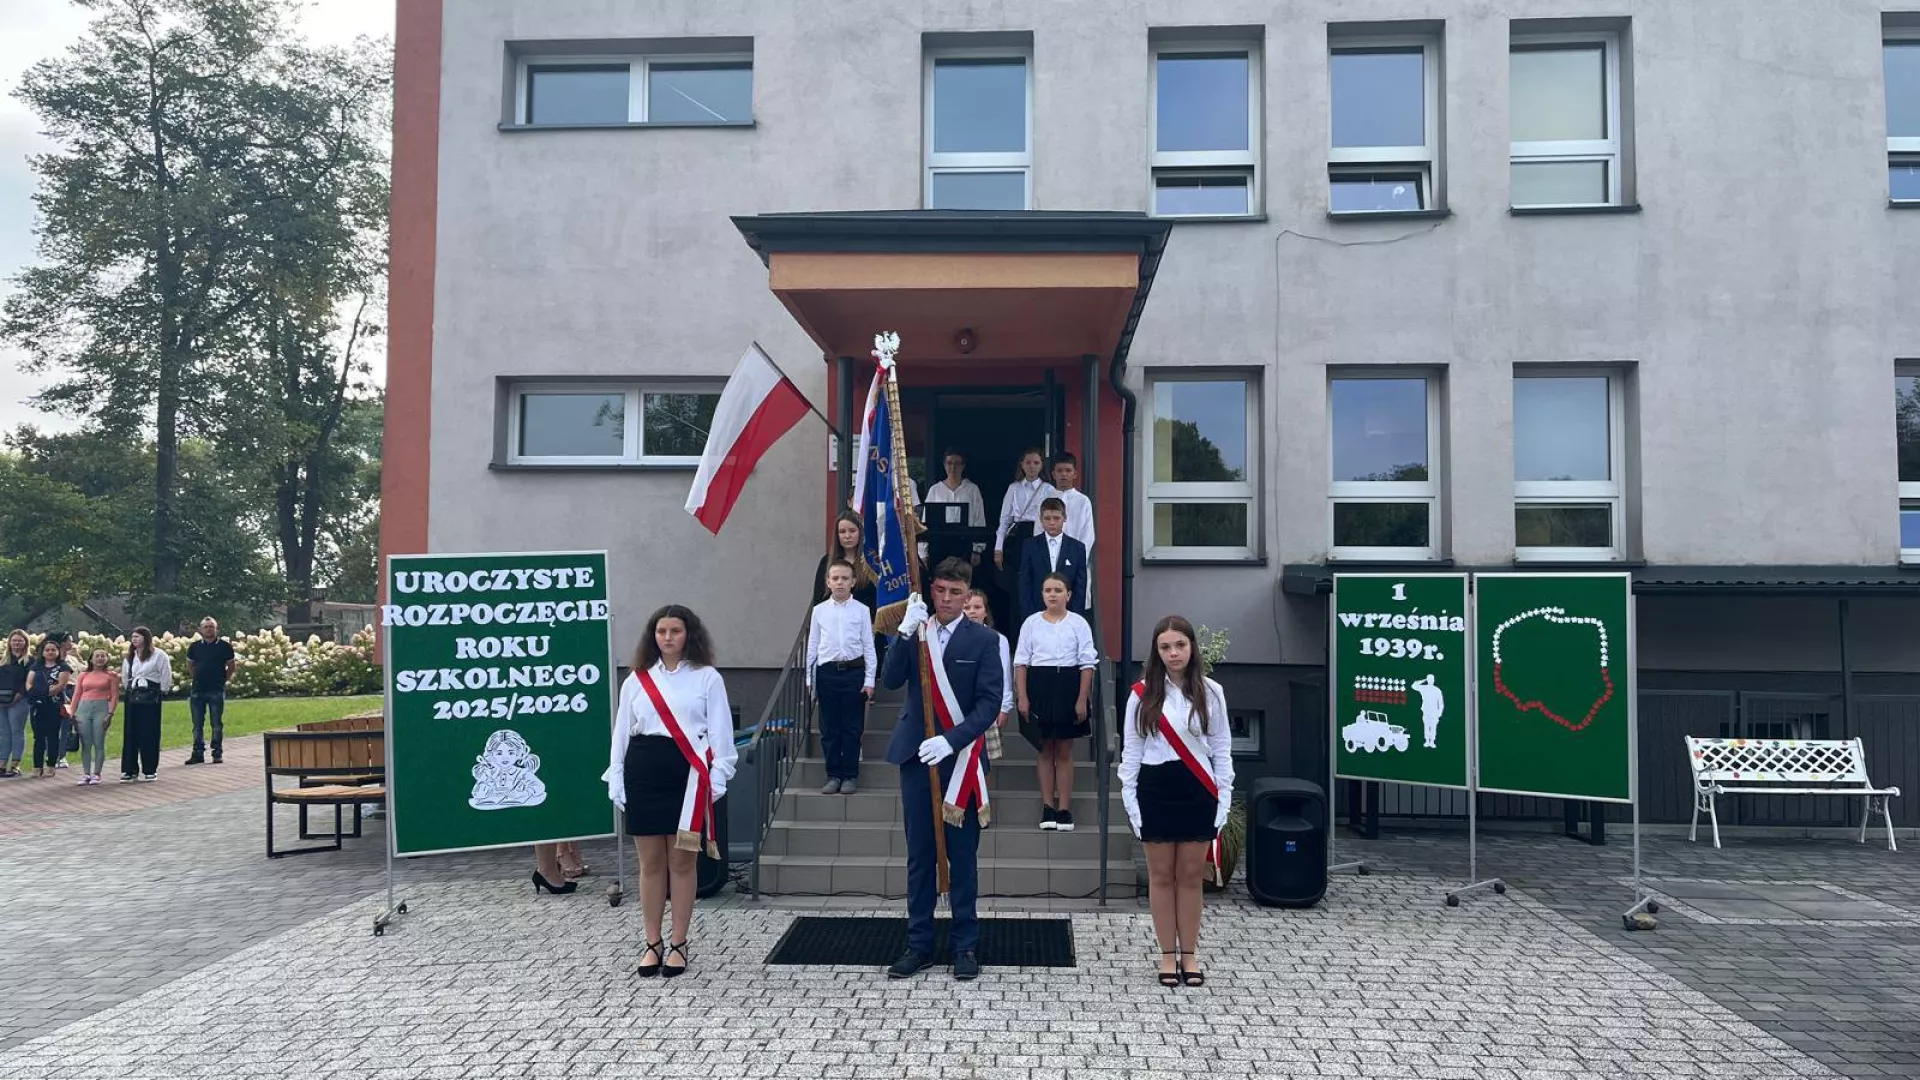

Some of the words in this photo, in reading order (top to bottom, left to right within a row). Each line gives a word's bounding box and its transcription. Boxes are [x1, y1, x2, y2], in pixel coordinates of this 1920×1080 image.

[394, 567, 594, 593] UROCZYSTE
[1391, 583, 1407, 601] 1
[381, 600, 609, 627] ROZPOCZĘCIE
[1338, 607, 1464, 631] września
[455, 636, 550, 659] ROKU
[1360, 637, 1444, 660] 1939r.
[396, 664, 600, 691] SZKOLNEGO
[433, 693, 588, 720] 2025/2026
